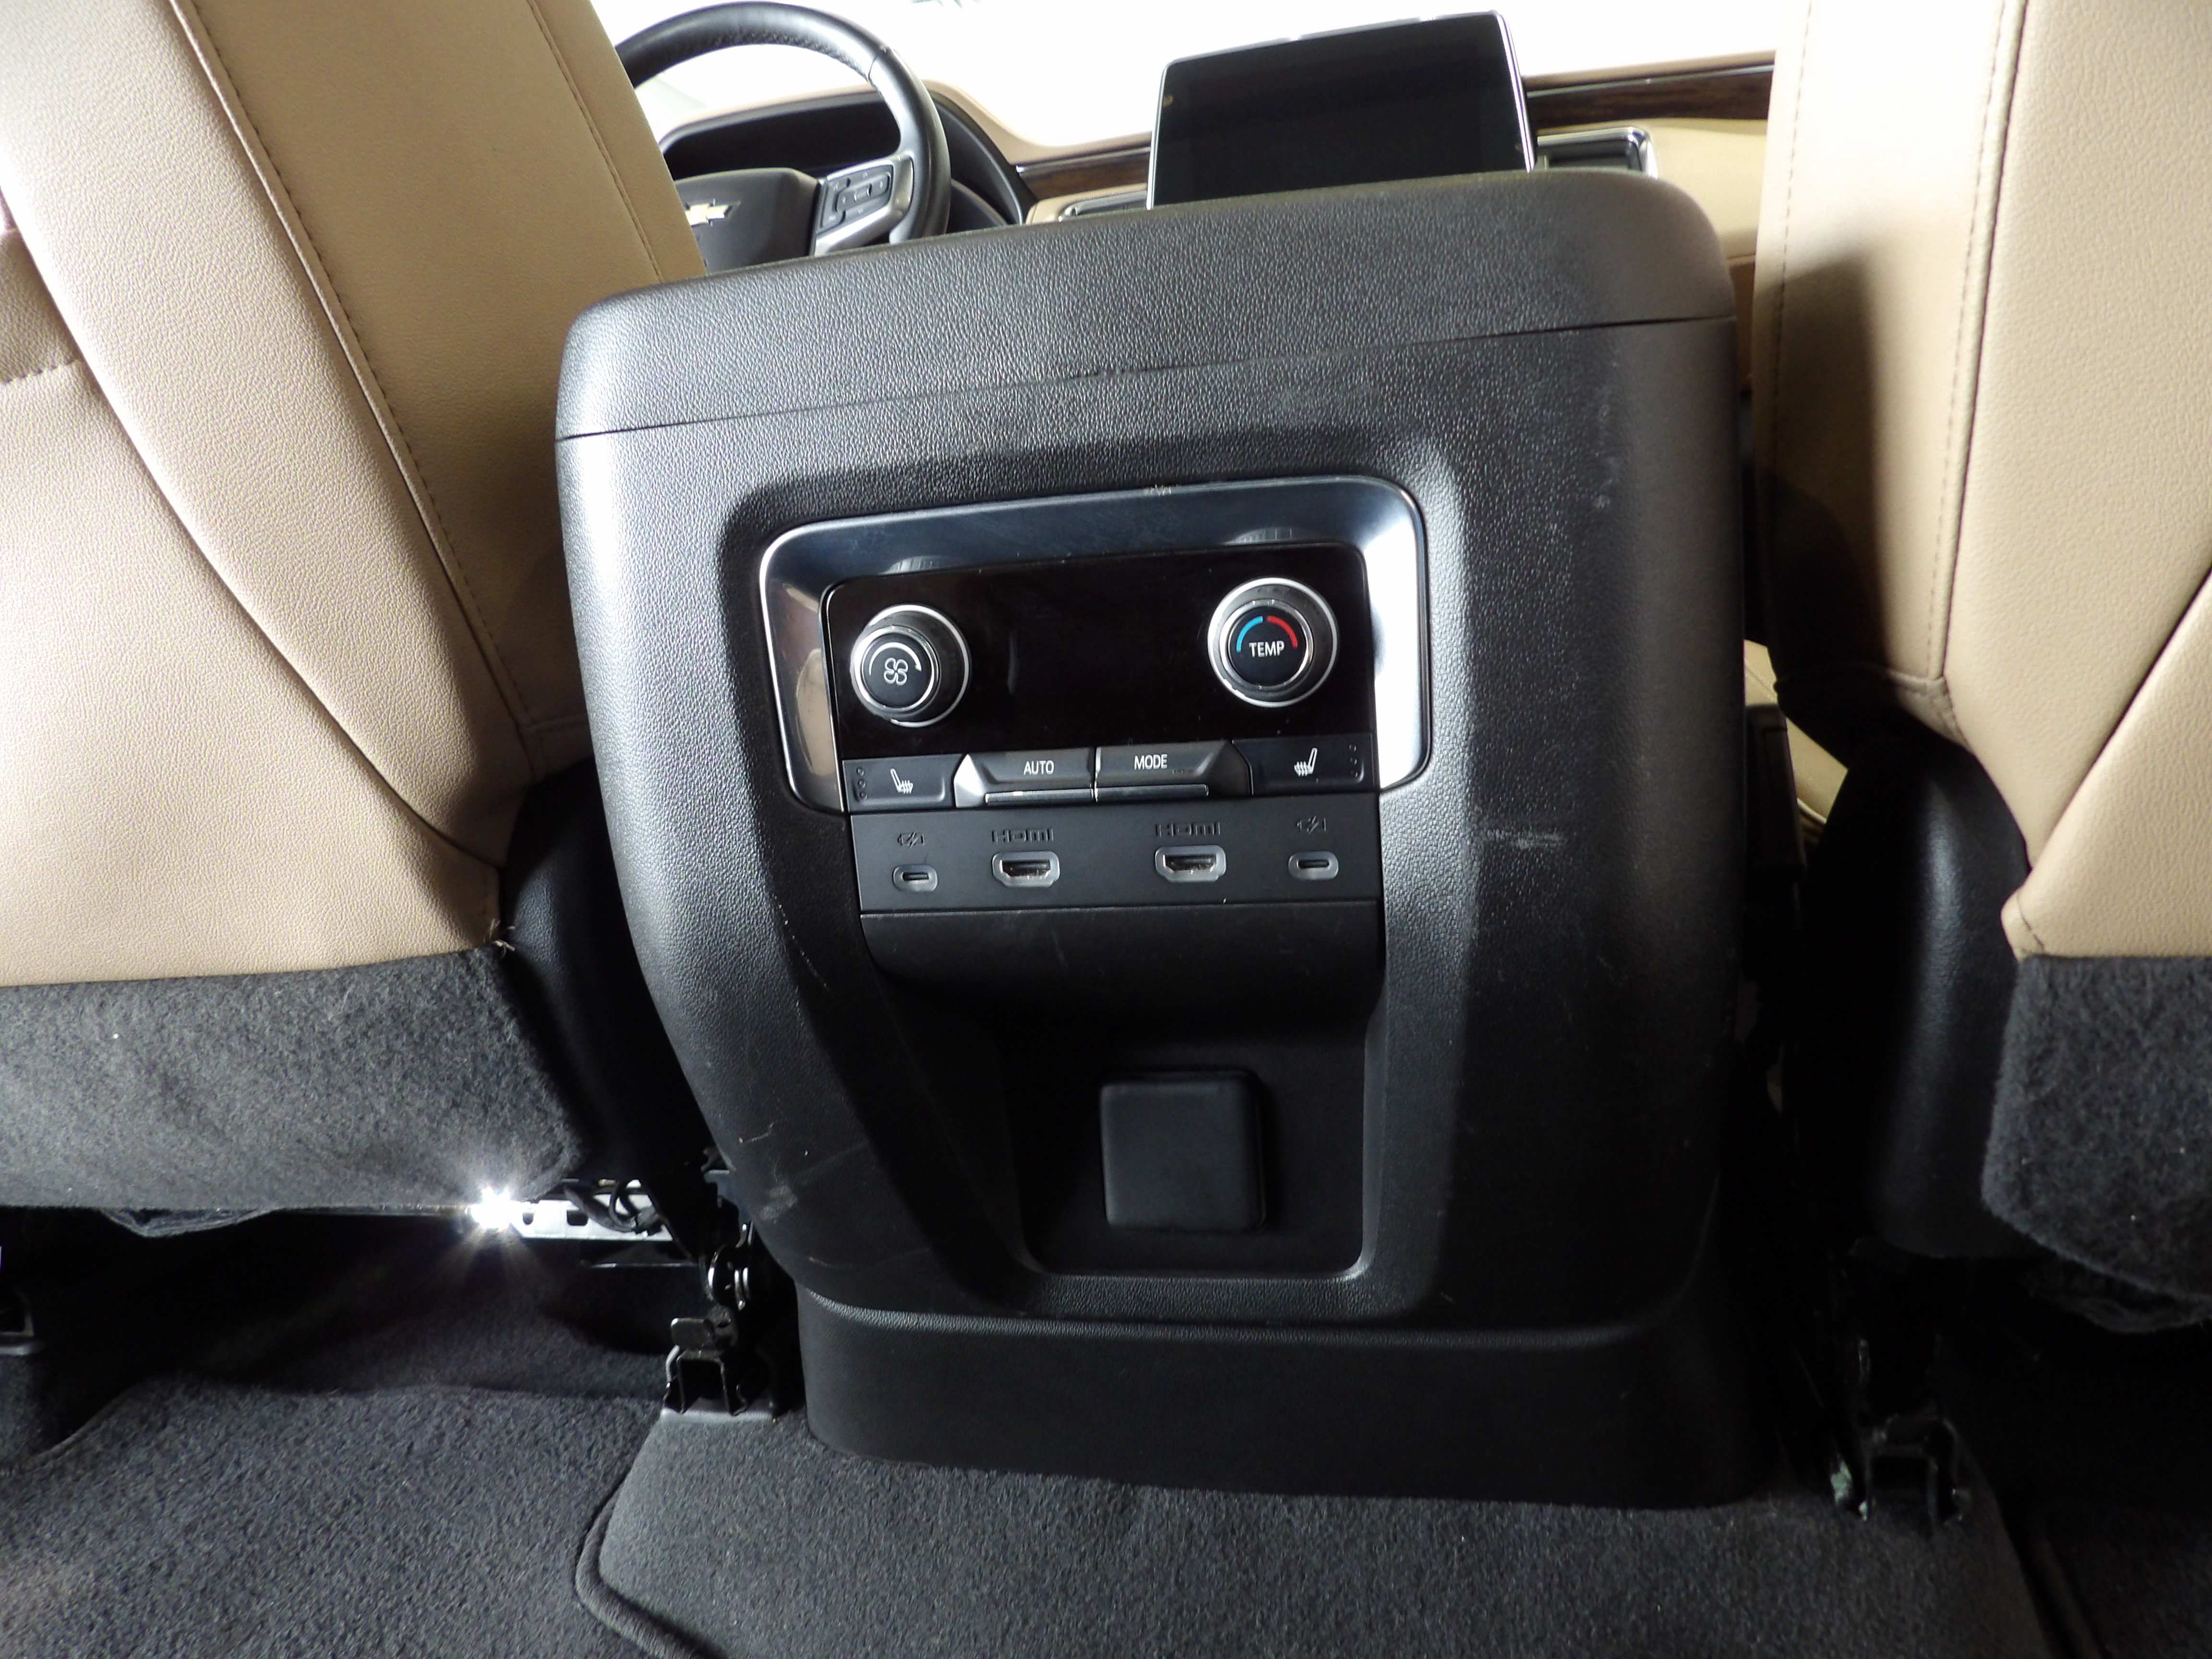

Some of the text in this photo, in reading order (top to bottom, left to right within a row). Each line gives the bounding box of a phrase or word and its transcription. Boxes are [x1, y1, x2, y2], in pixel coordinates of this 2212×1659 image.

[1249, 640, 1285, 658] TEMP
[1023, 760, 1054, 775] AUTO
[1134, 754, 1168, 770] MODE
